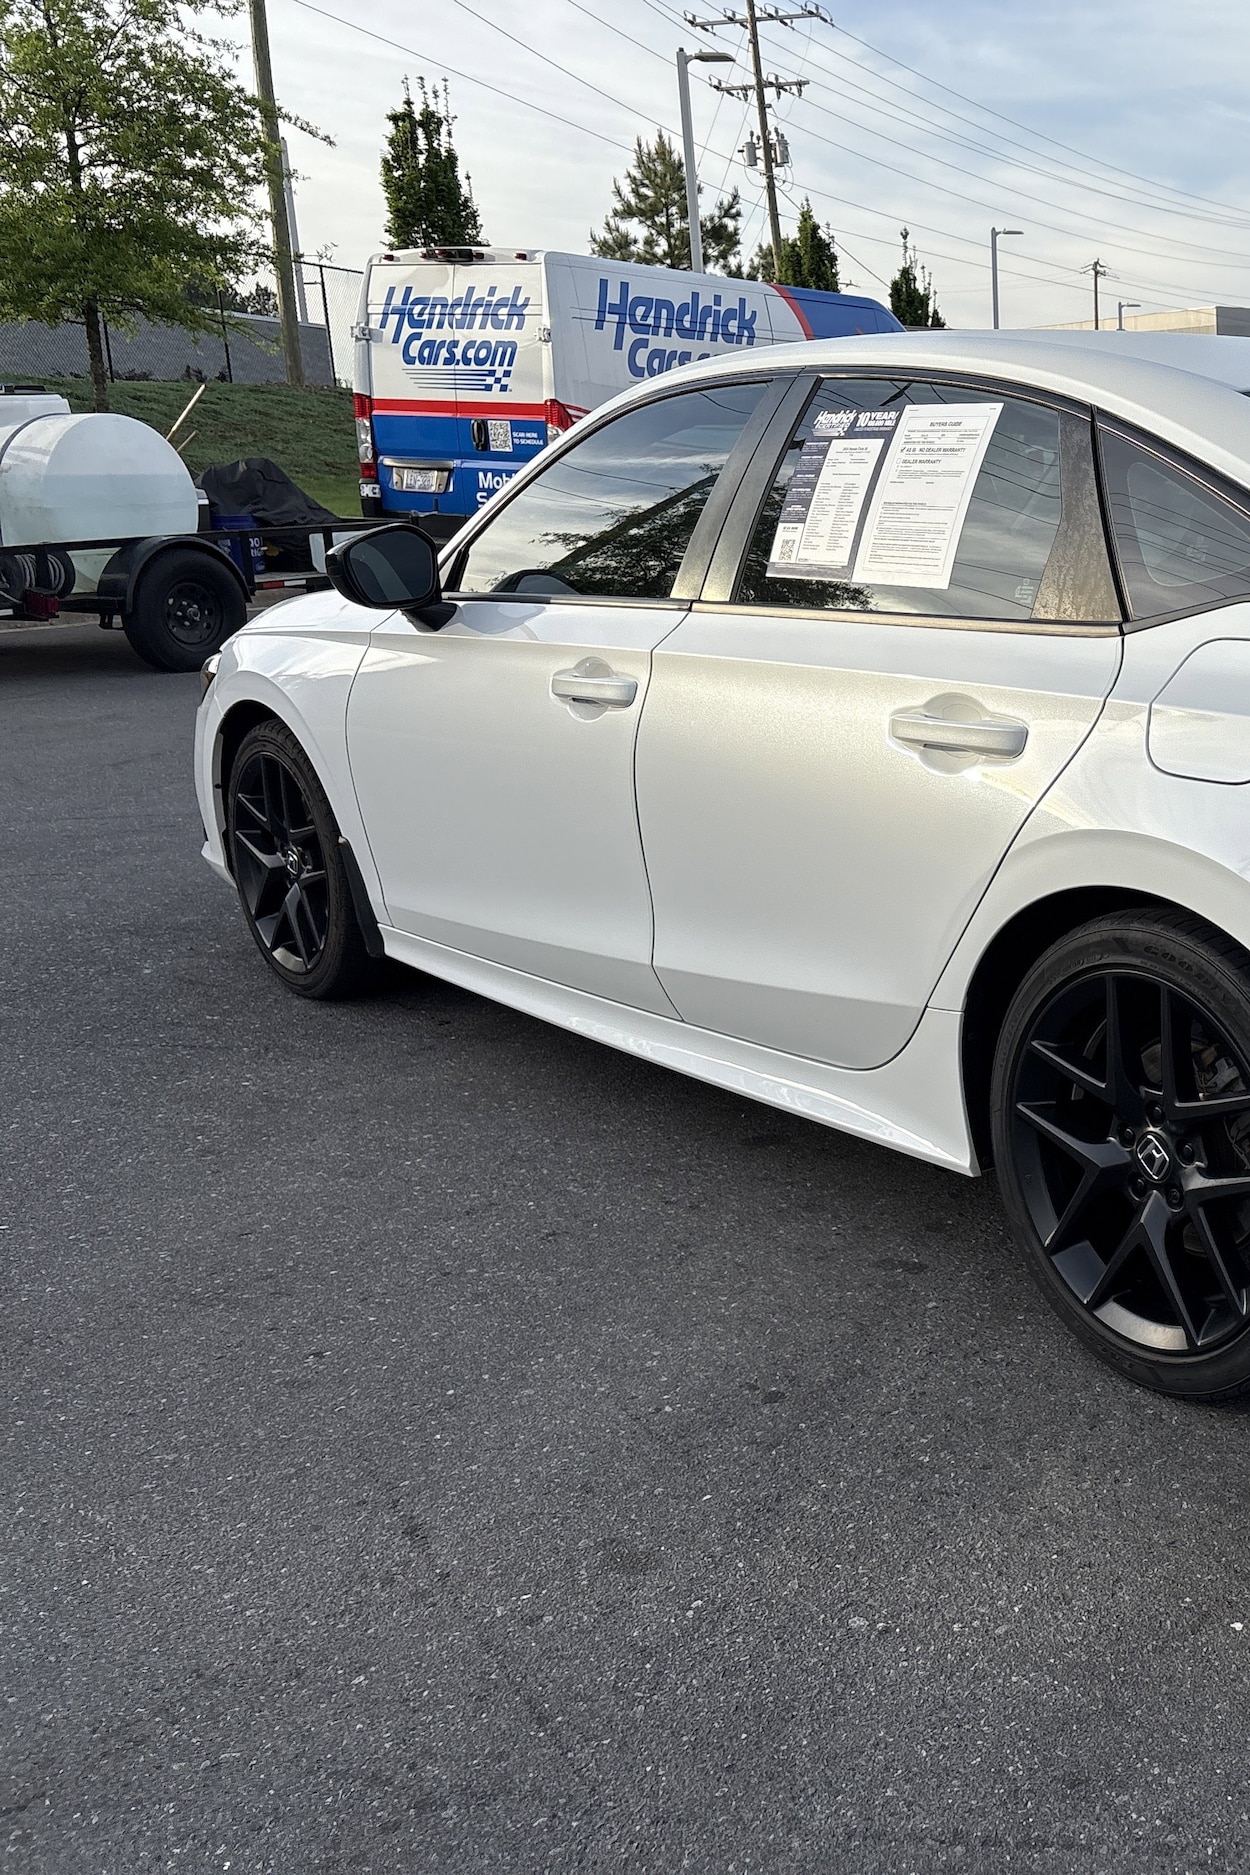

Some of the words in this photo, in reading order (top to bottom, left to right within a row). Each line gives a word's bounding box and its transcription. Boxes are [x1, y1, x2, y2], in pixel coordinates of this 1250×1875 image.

[379, 286, 531, 344] Hendrick
[594, 278, 757, 351] Hendrick
[402, 331, 518, 367] Cars.com
